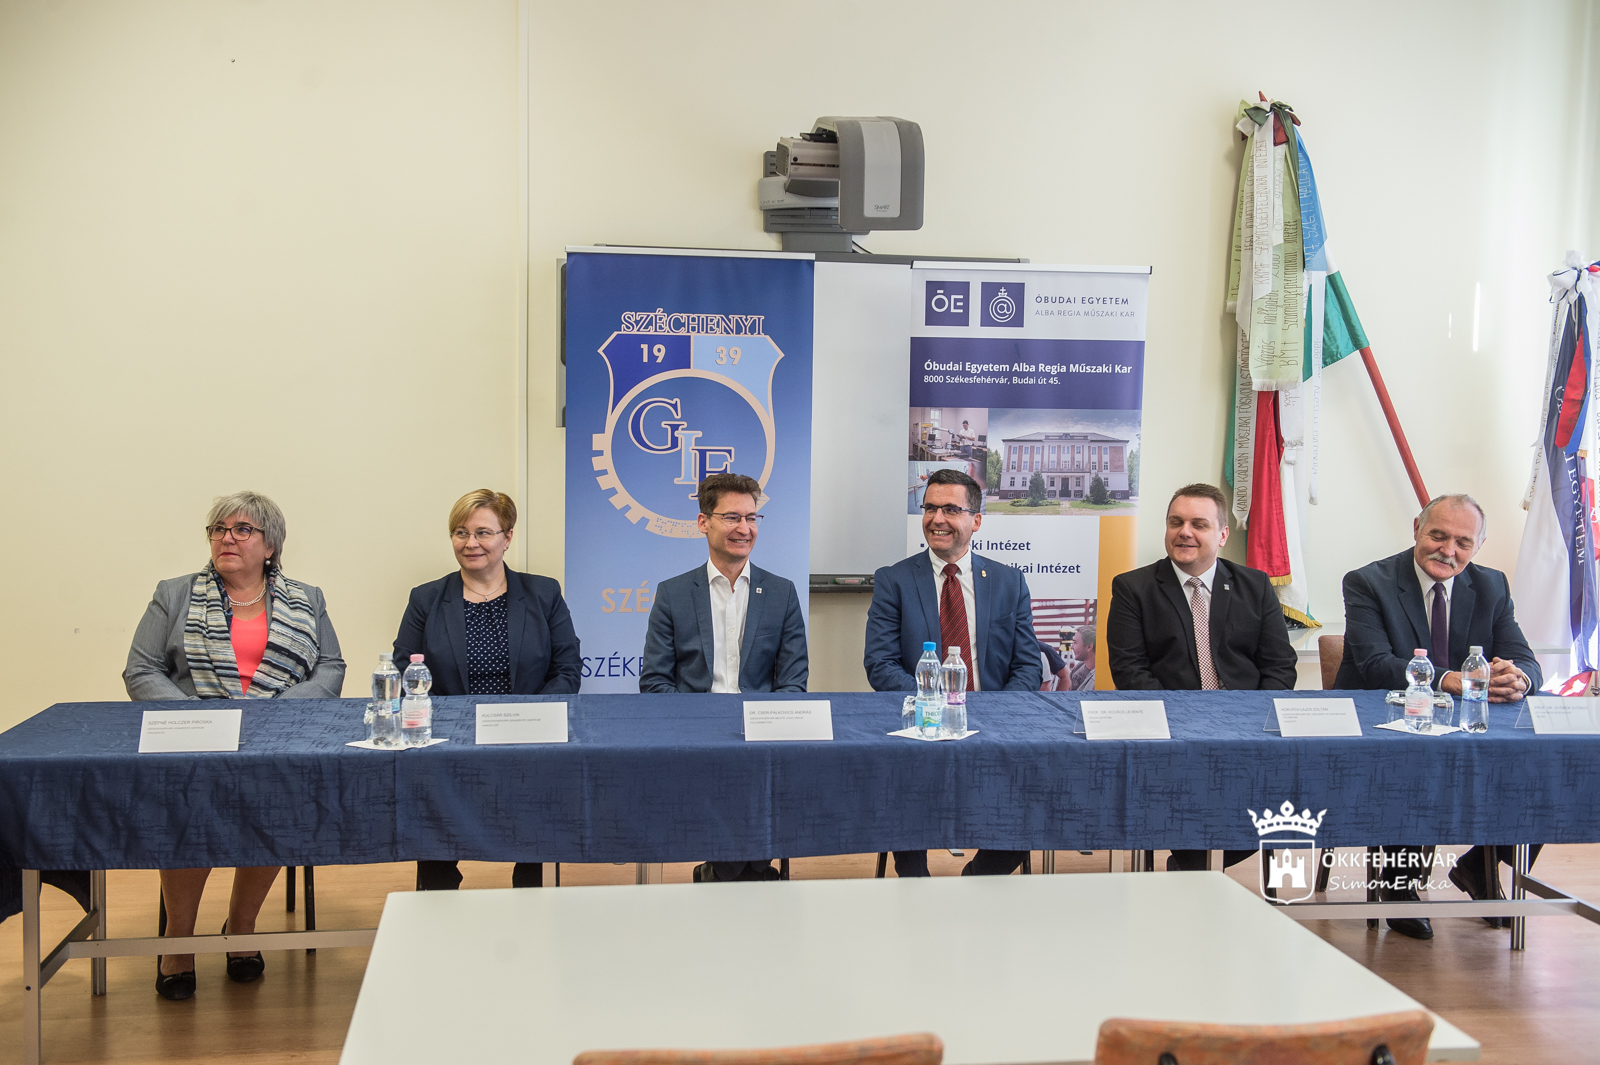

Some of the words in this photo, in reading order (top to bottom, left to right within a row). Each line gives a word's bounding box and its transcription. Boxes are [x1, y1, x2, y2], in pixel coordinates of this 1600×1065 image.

[1035, 294, 1076, 304] ÓBUDAI
[1081, 297, 1129, 305] EGYETEM
[621, 307, 765, 336] SZÉCHENYI
[1035, 309, 1055, 317] ALBA
[1083, 309, 1118, 318] MŰSZAKI
[640, 343, 666, 363] 19
[715, 346, 742, 366] 39
[924, 359, 963, 371] Óbudai
[965, 362, 1010, 374] Egyetem
[1012, 362, 1036, 373] Alba
[1038, 363, 1067, 375] Regia
[1069, 363, 1112, 373] Műszaki
[1114, 364, 1132, 374] Kar
[923, 375, 944, 383] 8000
[945, 375, 1010, 385] Székesfehérvár,
[1012, 376, 1036, 385] Budai
[1038, 376, 1047, 385] út
[1048, 377, 1061, 385] 45.
[1236, 452, 1250, 482] KÁLMÁN
[1235, 485, 1248, 512] KANDÓ
[1567, 468, 1585, 566] EGYETEM
[971, 540, 982, 551] ki
[986, 540, 1031, 551] Intézet
[1037, 563, 1081, 574] Intézet
[601, 580, 657, 614] SZÉ
